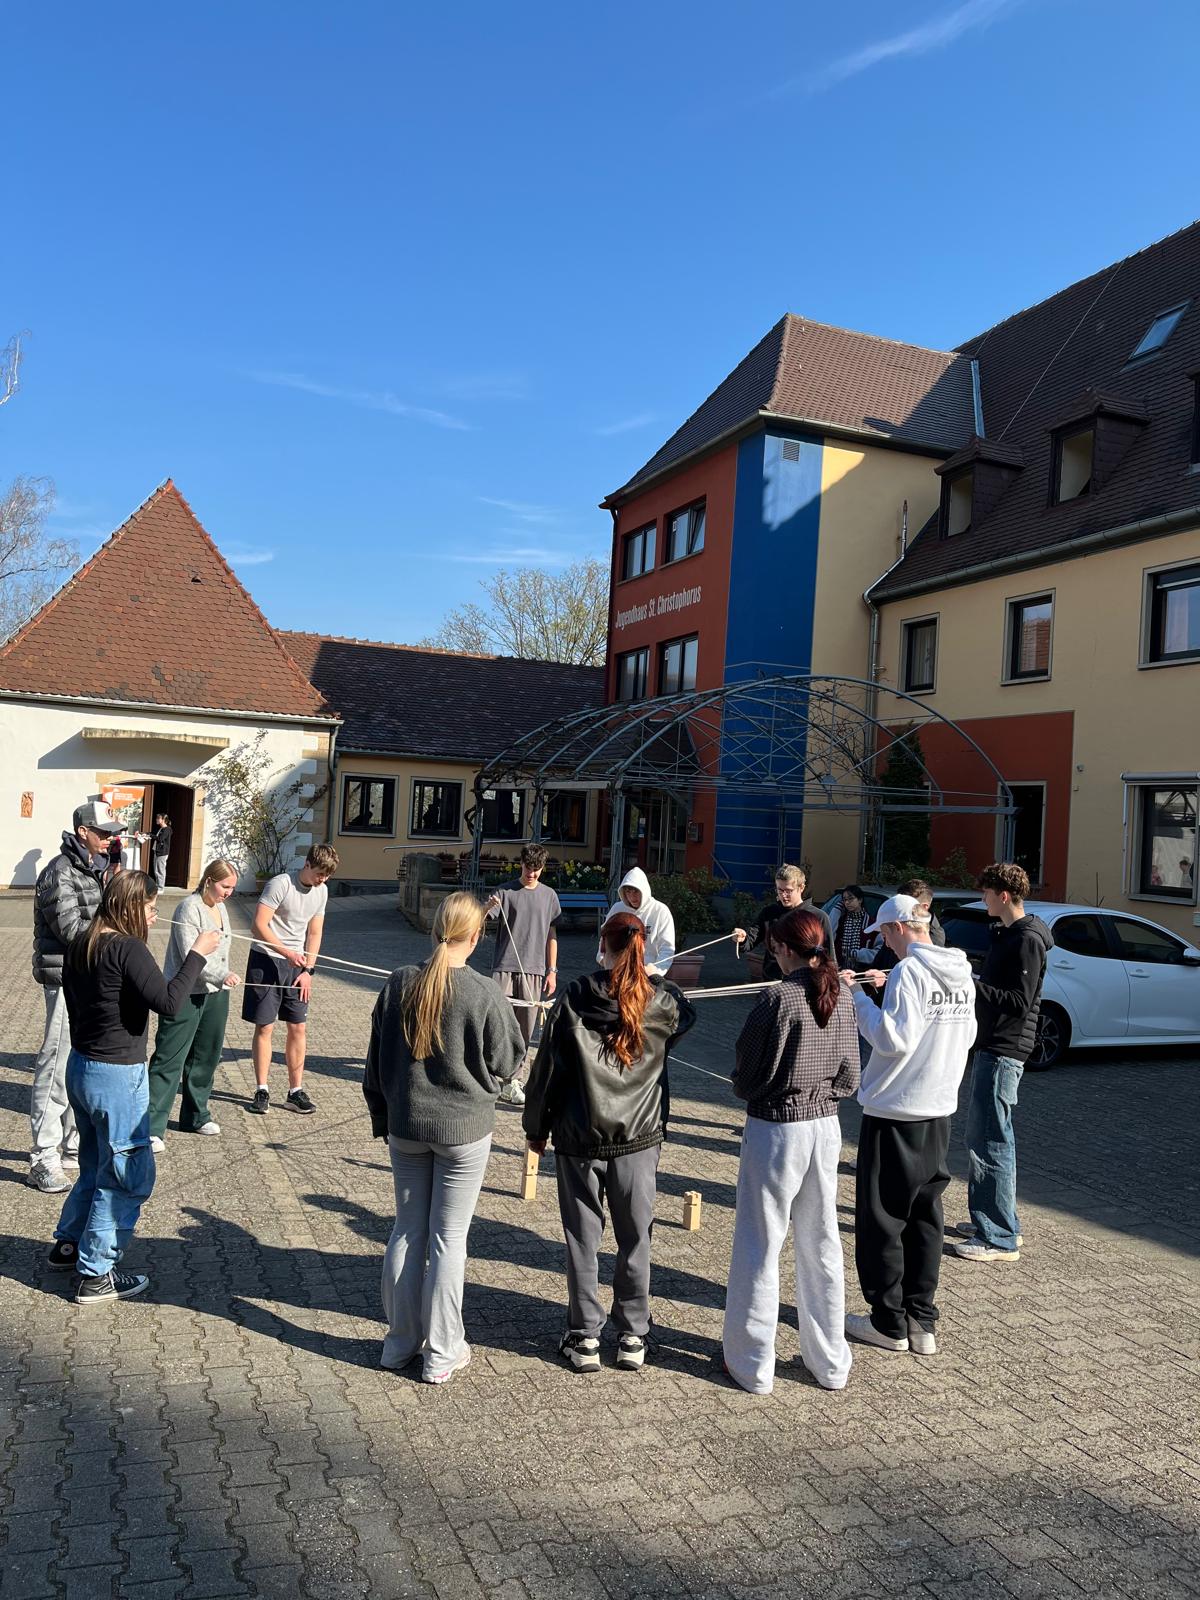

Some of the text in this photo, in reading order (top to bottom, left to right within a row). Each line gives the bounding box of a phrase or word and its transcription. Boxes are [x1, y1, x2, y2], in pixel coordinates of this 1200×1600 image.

[615, 586, 702, 631] Jugendhaus St. Christophorus
